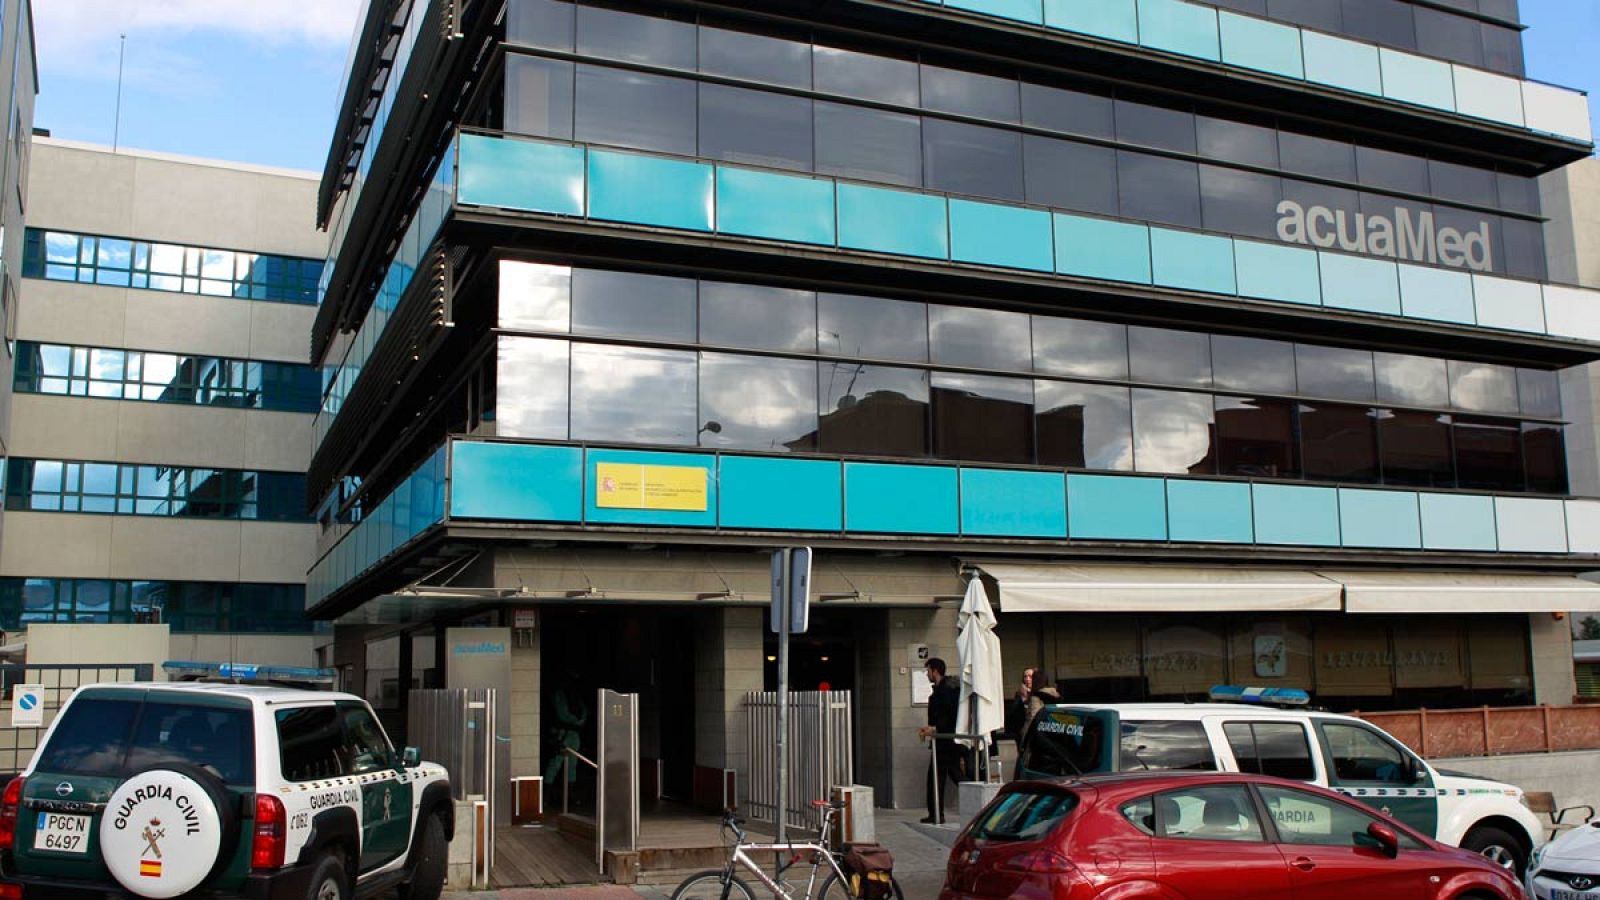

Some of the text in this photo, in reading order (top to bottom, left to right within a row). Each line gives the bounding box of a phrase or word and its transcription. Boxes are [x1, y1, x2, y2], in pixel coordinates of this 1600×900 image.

[1276, 200, 1492, 272] acuaMed
[1037, 721, 1085, 736] GUARDIA CIVIL
[310, 789, 359, 809] GUARDIA CIVIL
[115, 784, 201, 836] GUARDIA CIVIL
[48, 815, 85, 832] PGCN
[46, 834, 80, 850] 6497
